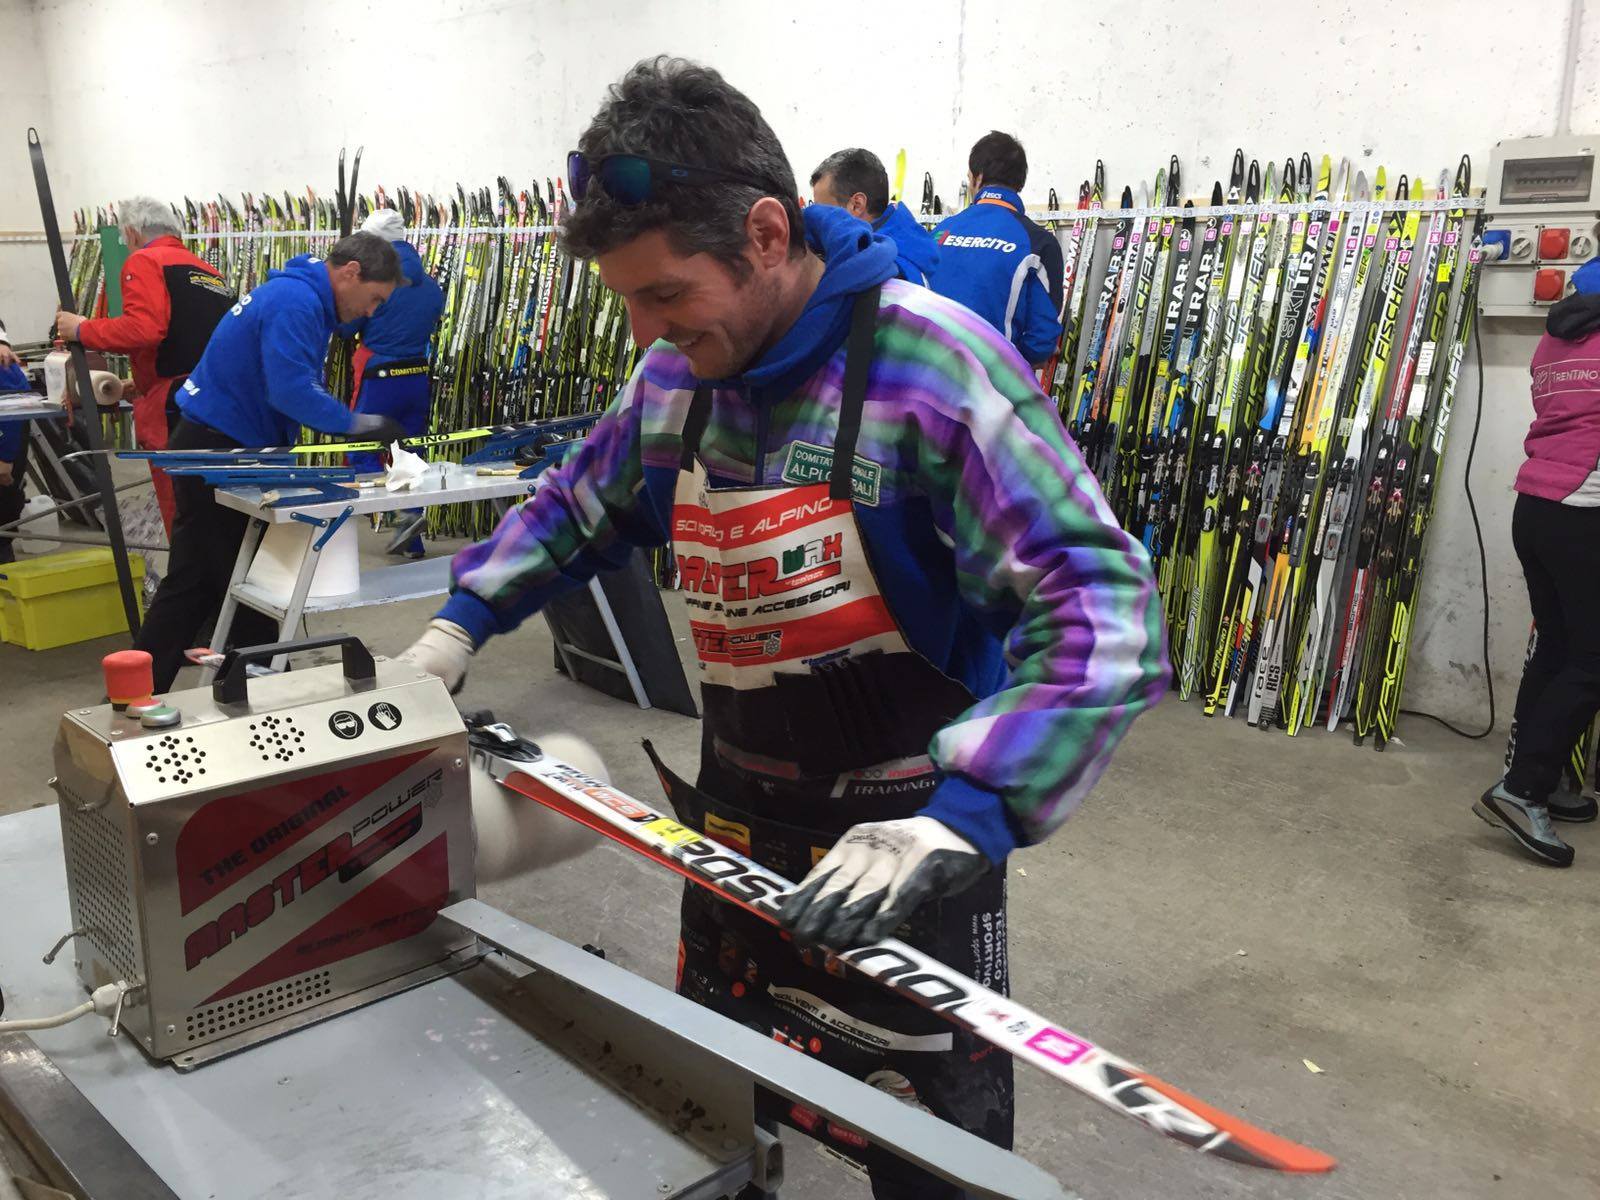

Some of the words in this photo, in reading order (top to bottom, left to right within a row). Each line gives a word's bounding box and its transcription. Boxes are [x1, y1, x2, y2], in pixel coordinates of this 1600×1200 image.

[944, 235, 1017, 253] ESERCITO
[1307, 231, 1337, 326] SALOMO
[1552, 369, 1599, 381] TRENTINO
[730, 524, 744, 539] E
[751, 496, 834, 535] ALPINO
[752, 581, 850, 616] ACCESSORI
[1253, 646, 1271, 699] race
[1265, 664, 1281, 692] RCS
[353, 767, 442, 838] POWER
[200, 851, 249, 886] THE
[250, 785, 350, 853] ORIGINAL
[982, 912, 994, 988] SPORTIVO
[829, 1018, 891, 1048] ACCESSORI
